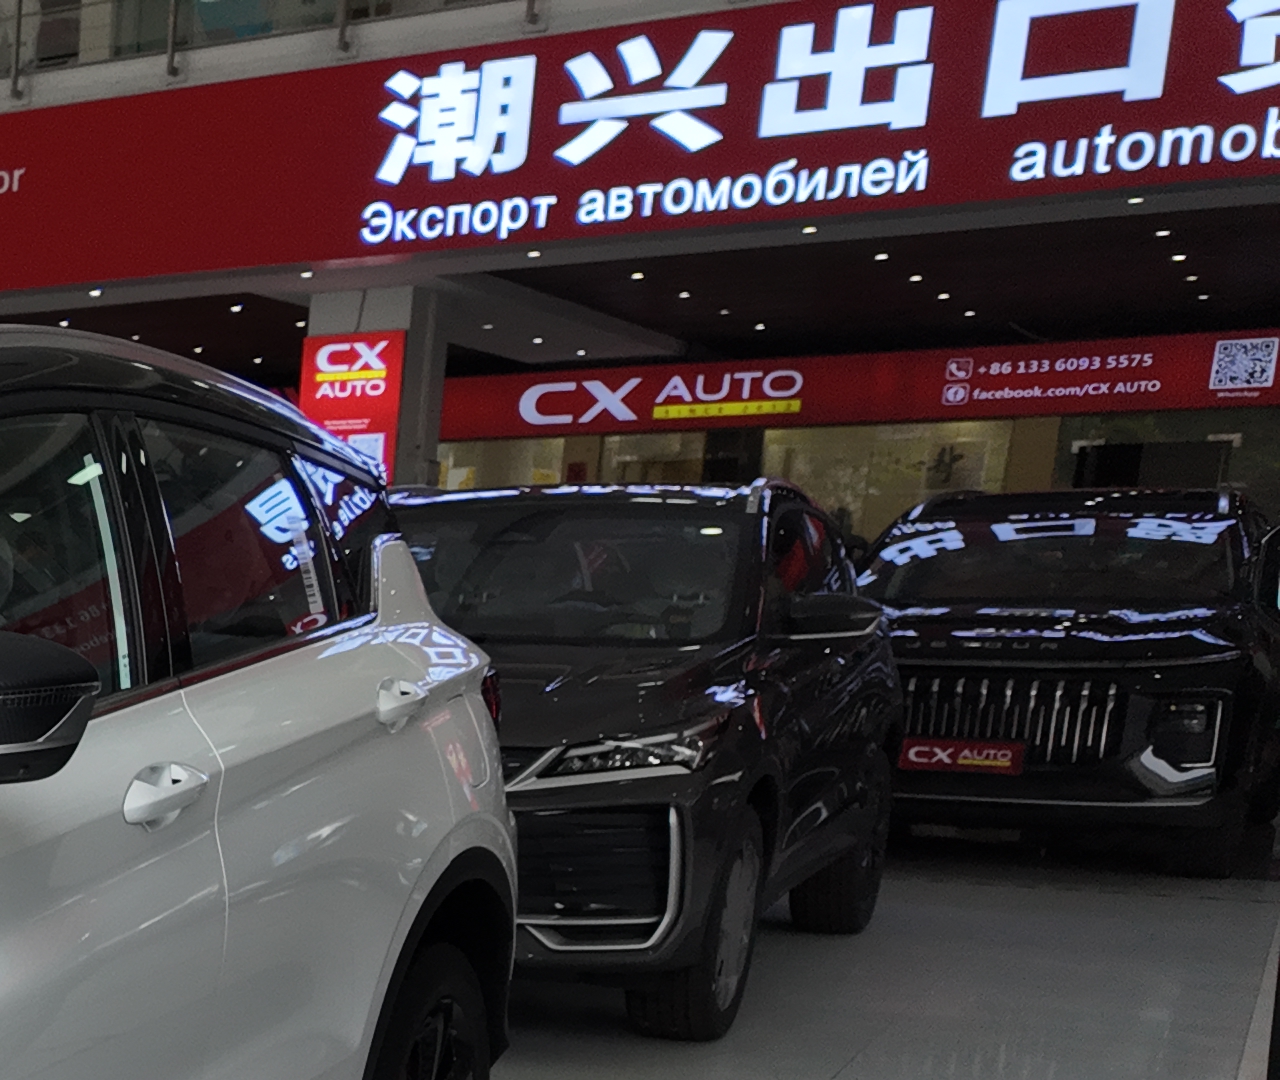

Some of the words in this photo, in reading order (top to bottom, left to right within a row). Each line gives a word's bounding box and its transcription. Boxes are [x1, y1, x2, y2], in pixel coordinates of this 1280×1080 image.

[359, 194, 558, 245] Экспорт
[577, 148, 930, 227] автомобилей
[315, 339, 390, 373] CX
[977, 361, 1012, 376] +86
[1016, 359, 1050, 375] 133
[1055, 356, 1101, 373] 6093
[1106, 353, 1154, 370] 5575
[315, 379, 387, 400] AUTO
[518, 377, 643, 426] CX
[654, 369, 804, 405] AUTO
[1113, 379, 1162, 394] AUTO
[907, 745, 955, 764] CX
[958, 747, 1013, 761] AUTO
